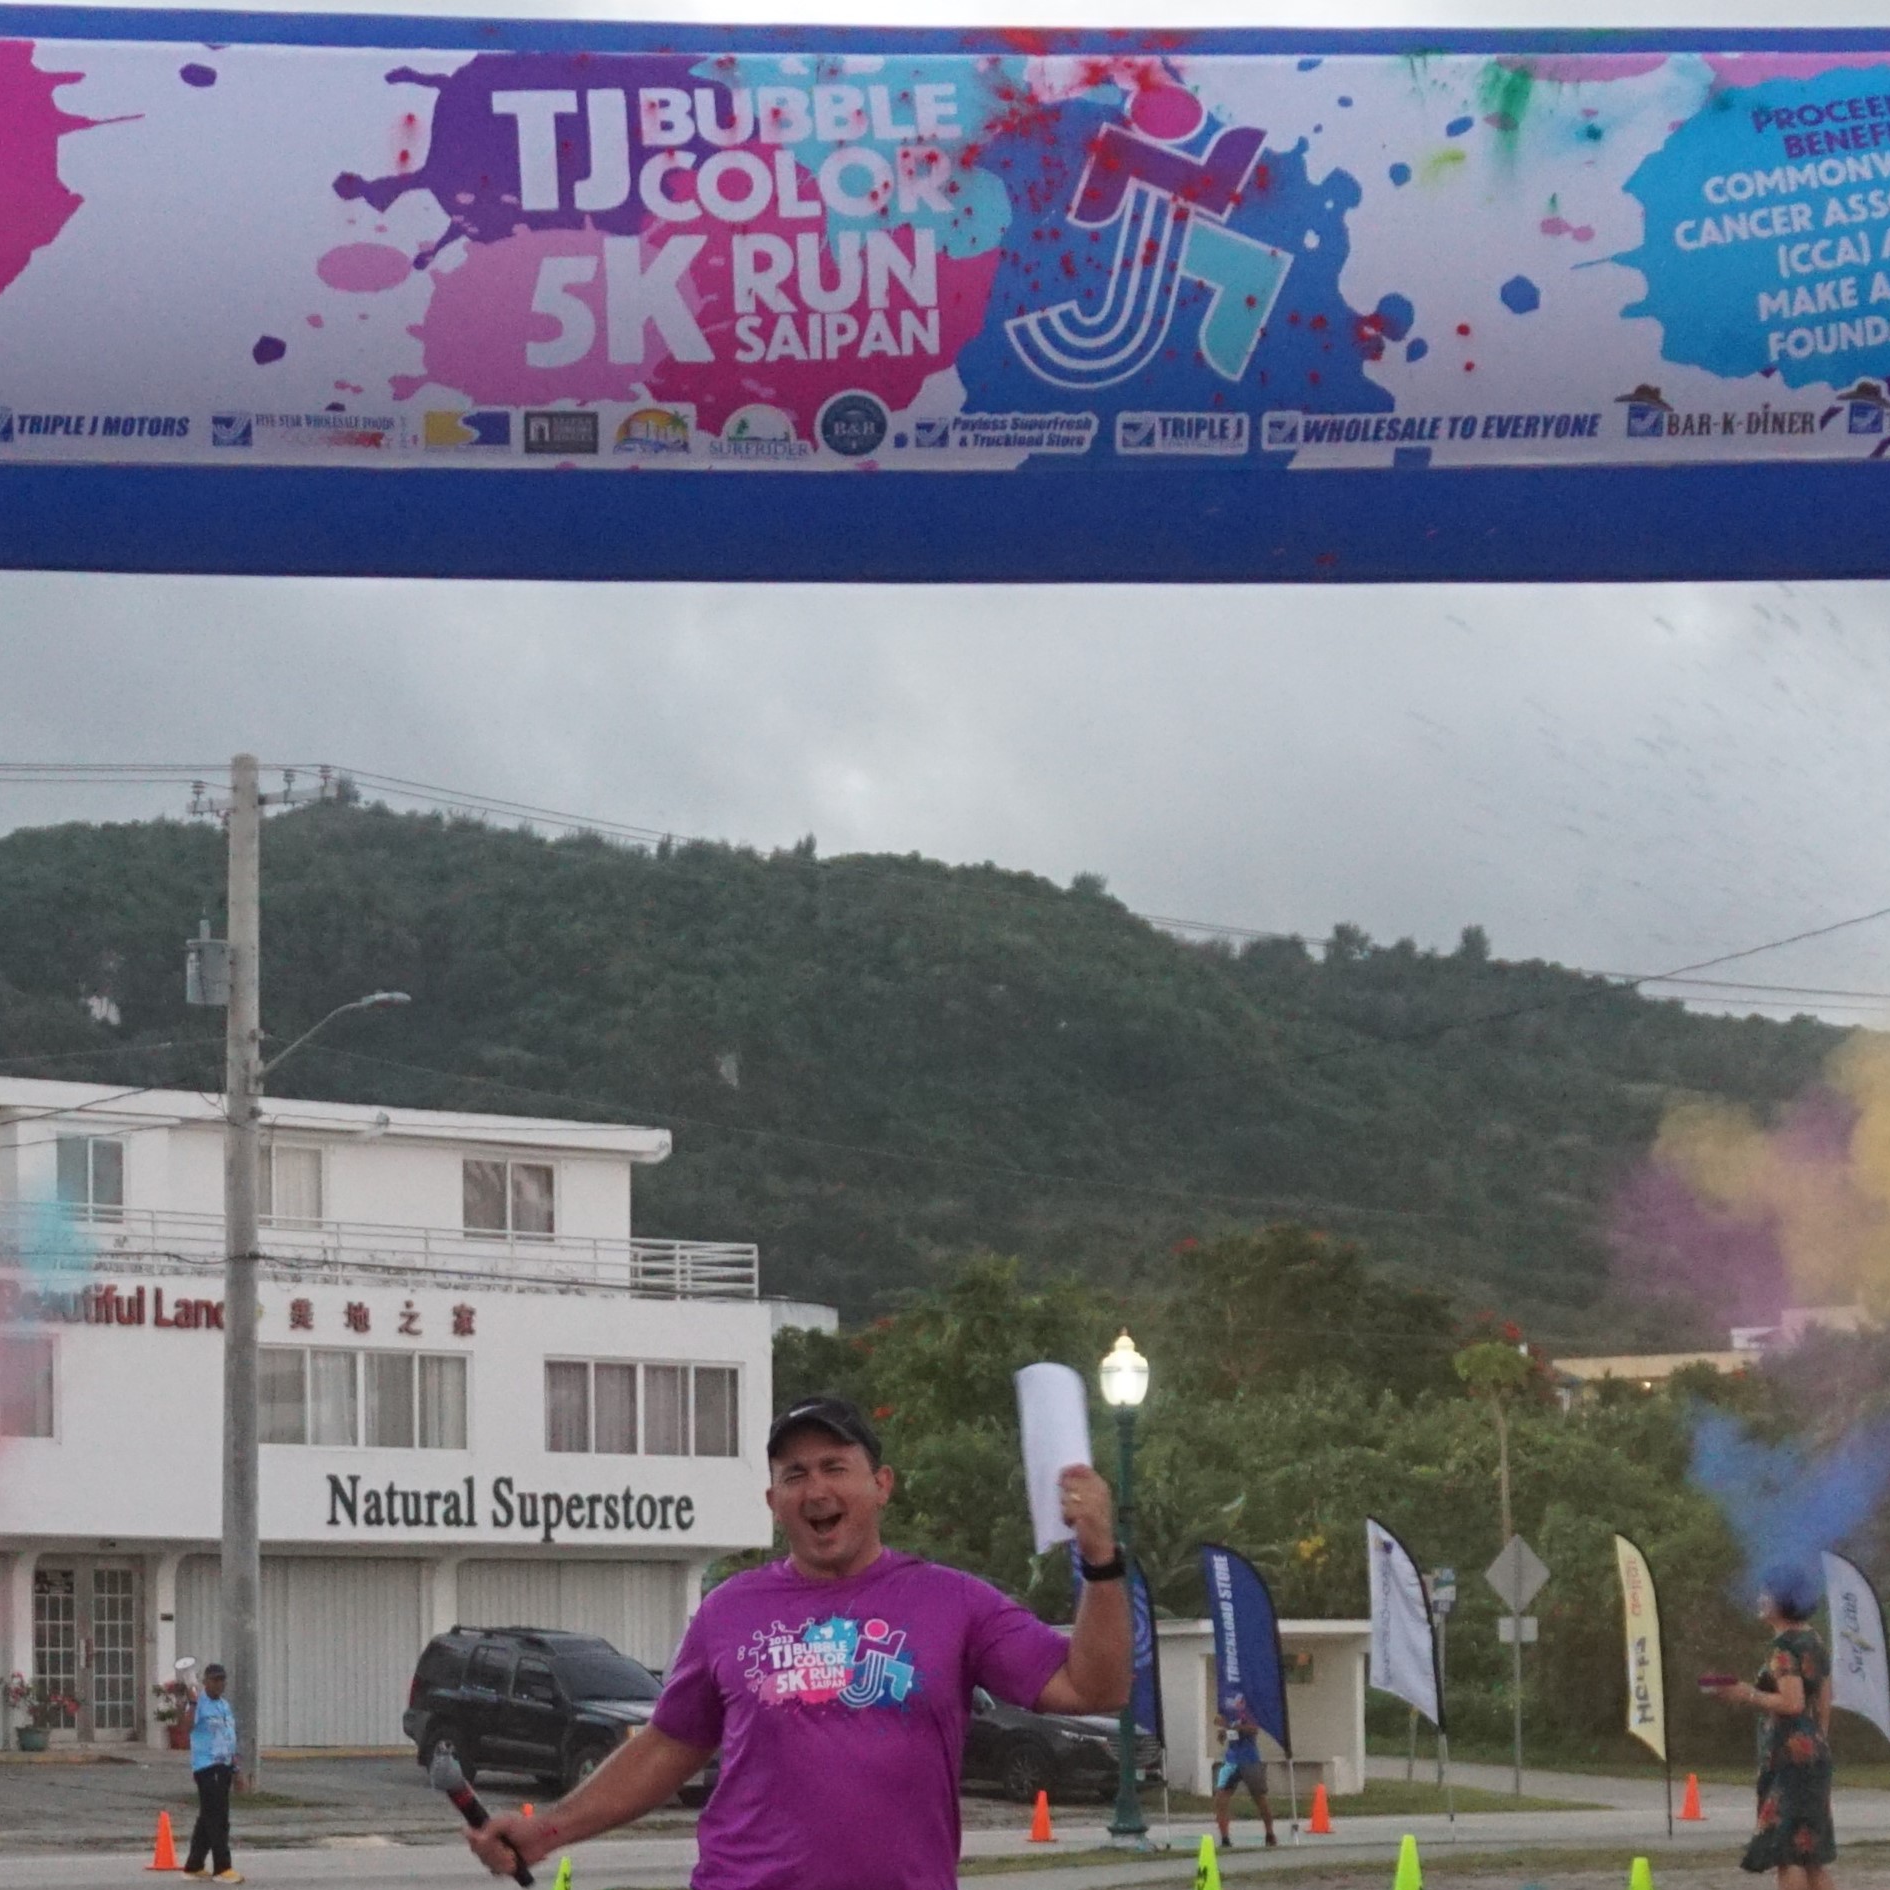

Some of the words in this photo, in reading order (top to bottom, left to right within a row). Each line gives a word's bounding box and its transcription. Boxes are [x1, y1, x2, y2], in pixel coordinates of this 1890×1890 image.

[492, 88, 631, 212] TJ
[639, 82, 963, 147] BUBBLE
[639, 146, 955, 222] COLOR
[1674, 202, 1814, 251] CANCER
[526, 233, 715, 369] 5K
[732, 228, 938, 314] RUN
[1757, 276, 1858, 322] MAKE
[735, 309, 941, 364] SAIPAN
[17, 414, 85, 436] TRIPLE
[87, 414, 100, 437] J
[101, 415, 190, 438] MOTORS
[280, 414, 303, 428] STAR
[1159, 416, 1230, 441] TRIPLE
[1232, 416, 1245, 441] J
[1302, 414, 1443, 443] WHOLESALE
[1448, 415, 1478, 441] TO
[1481, 413, 1603, 440] EVERYONE
[325, 1474, 478, 1528] Natural
[492, 1476, 696, 1542] Superstore
[1213, 1554, 1233, 1600] STORE
[768, 1644, 793, 1670] TJ
[792, 1640, 848, 1655] BUBBLE
[793, 1652, 848, 1669] COLOR
[1219, 1600, 1241, 1683] TRUCKLOAD
[776, 1669, 809, 1694] 5K
[809, 1666, 845, 1680] RUN
